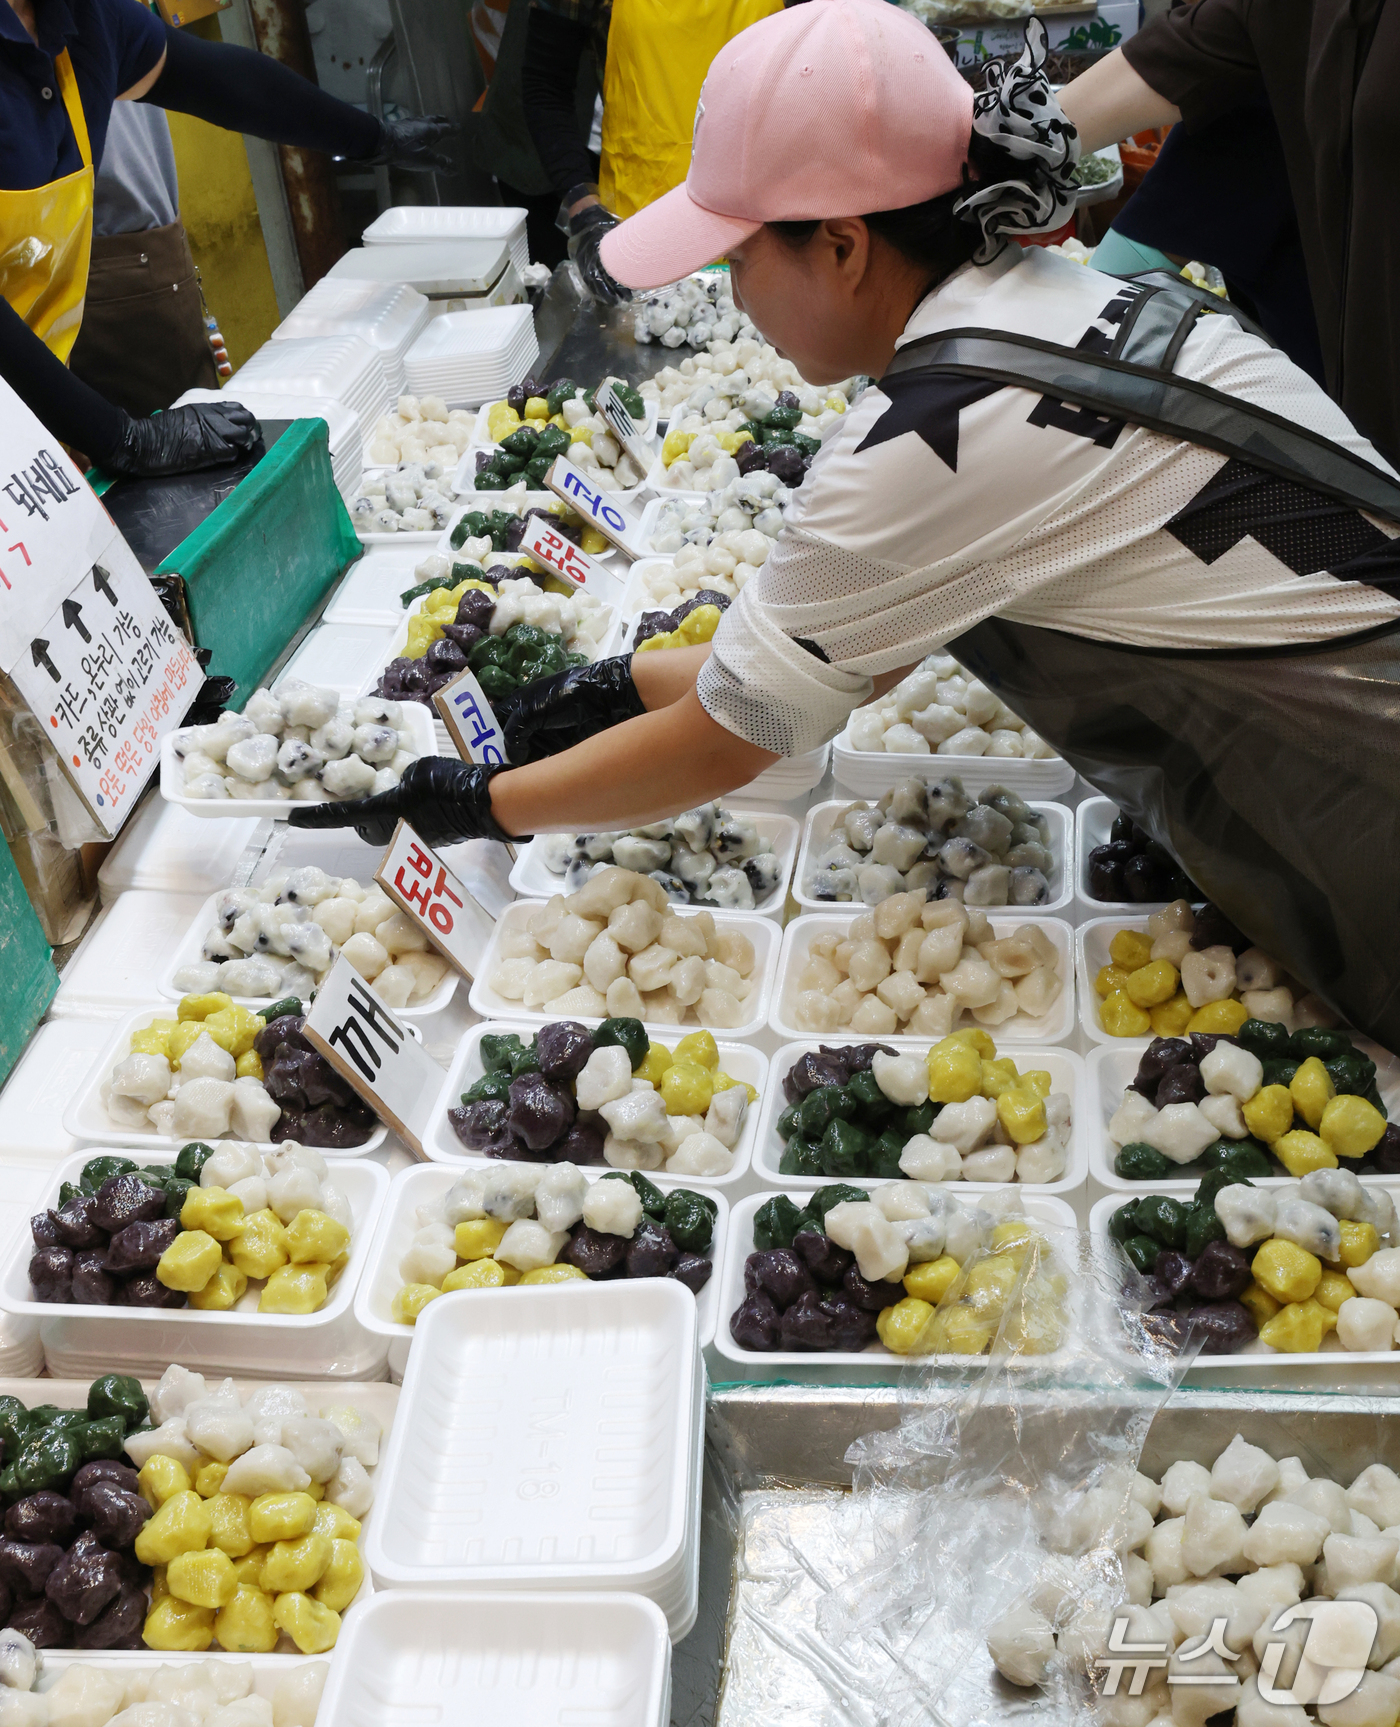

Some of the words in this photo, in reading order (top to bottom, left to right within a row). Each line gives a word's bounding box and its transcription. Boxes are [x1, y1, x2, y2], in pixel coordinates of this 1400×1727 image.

[604, 390, 640, 437] 깨
[563, 471, 627, 532] 콩
[533, 530, 591, 584] 동부
[112, 610, 142, 646] 가능
[77, 725, 109, 770] 종류
[131, 636, 161, 686] 고르기
[151, 616, 176, 645] 가능
[453, 690, 505, 764] 콩
[99, 768, 127, 808] 모든
[114, 740, 143, 777] 떡은
[132, 710, 158, 754] 당일
[149, 680, 176, 722] 아침에
[393, 841, 464, 936] 동부
[328, 977, 405, 1083] 깨
